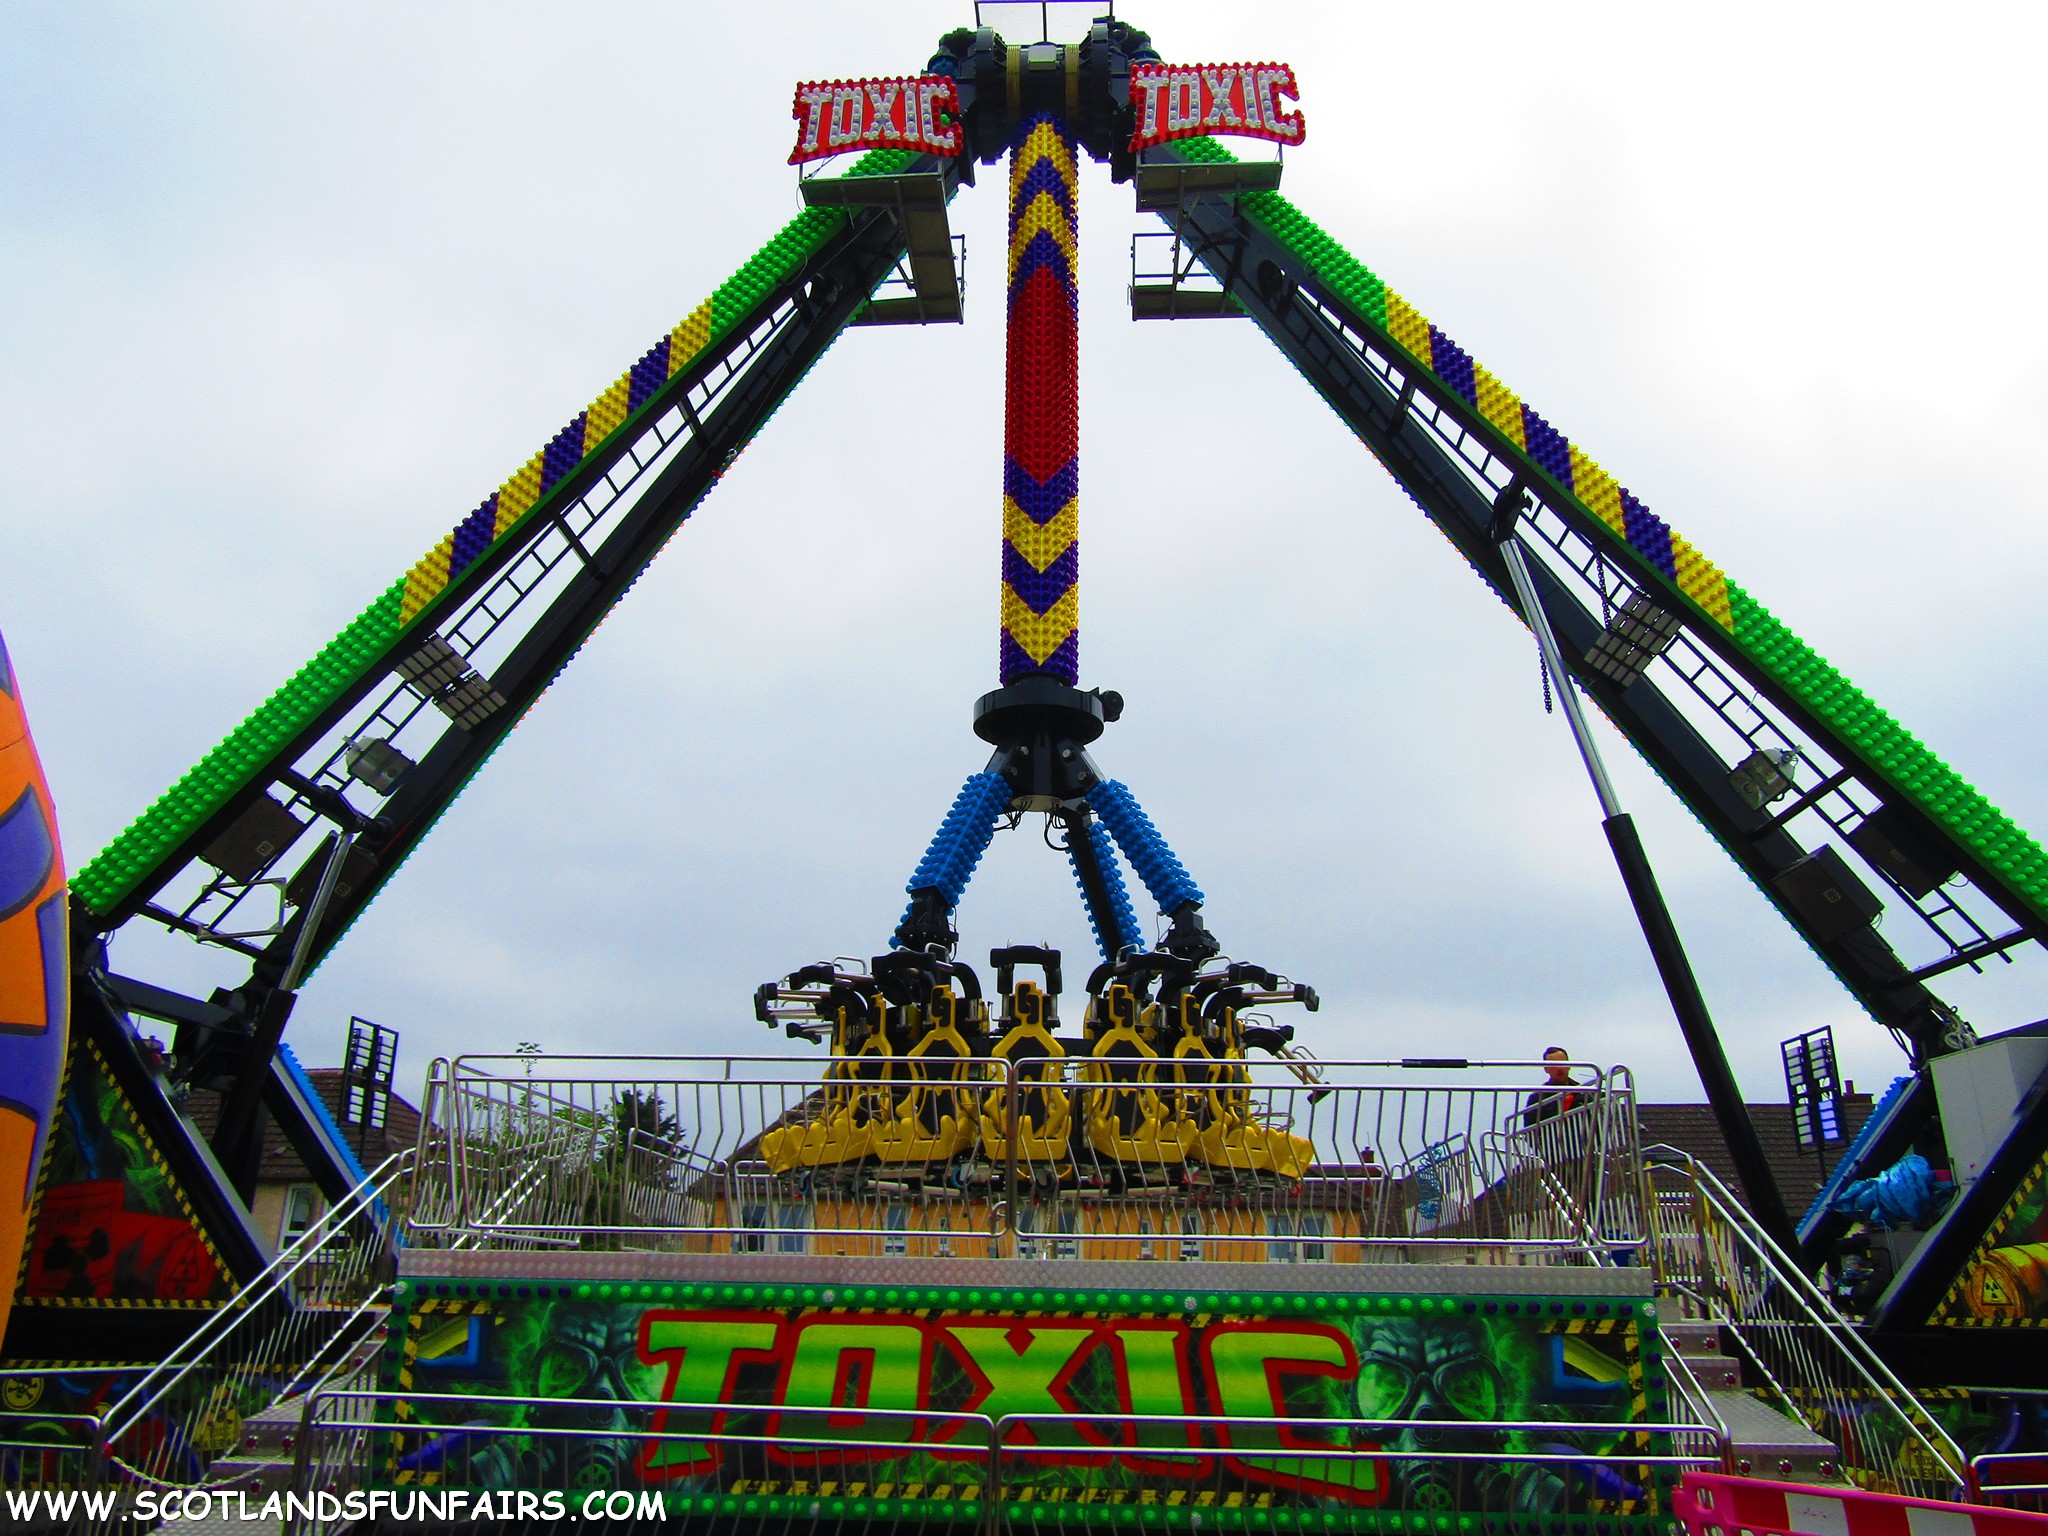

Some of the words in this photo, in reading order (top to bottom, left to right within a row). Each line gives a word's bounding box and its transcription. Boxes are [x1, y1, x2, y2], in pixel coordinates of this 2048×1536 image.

[799, 81, 957, 153] TOXIC
[1134, 66, 1302, 138] TOXIC
[638, 1309, 1387, 1504] TOXIC
